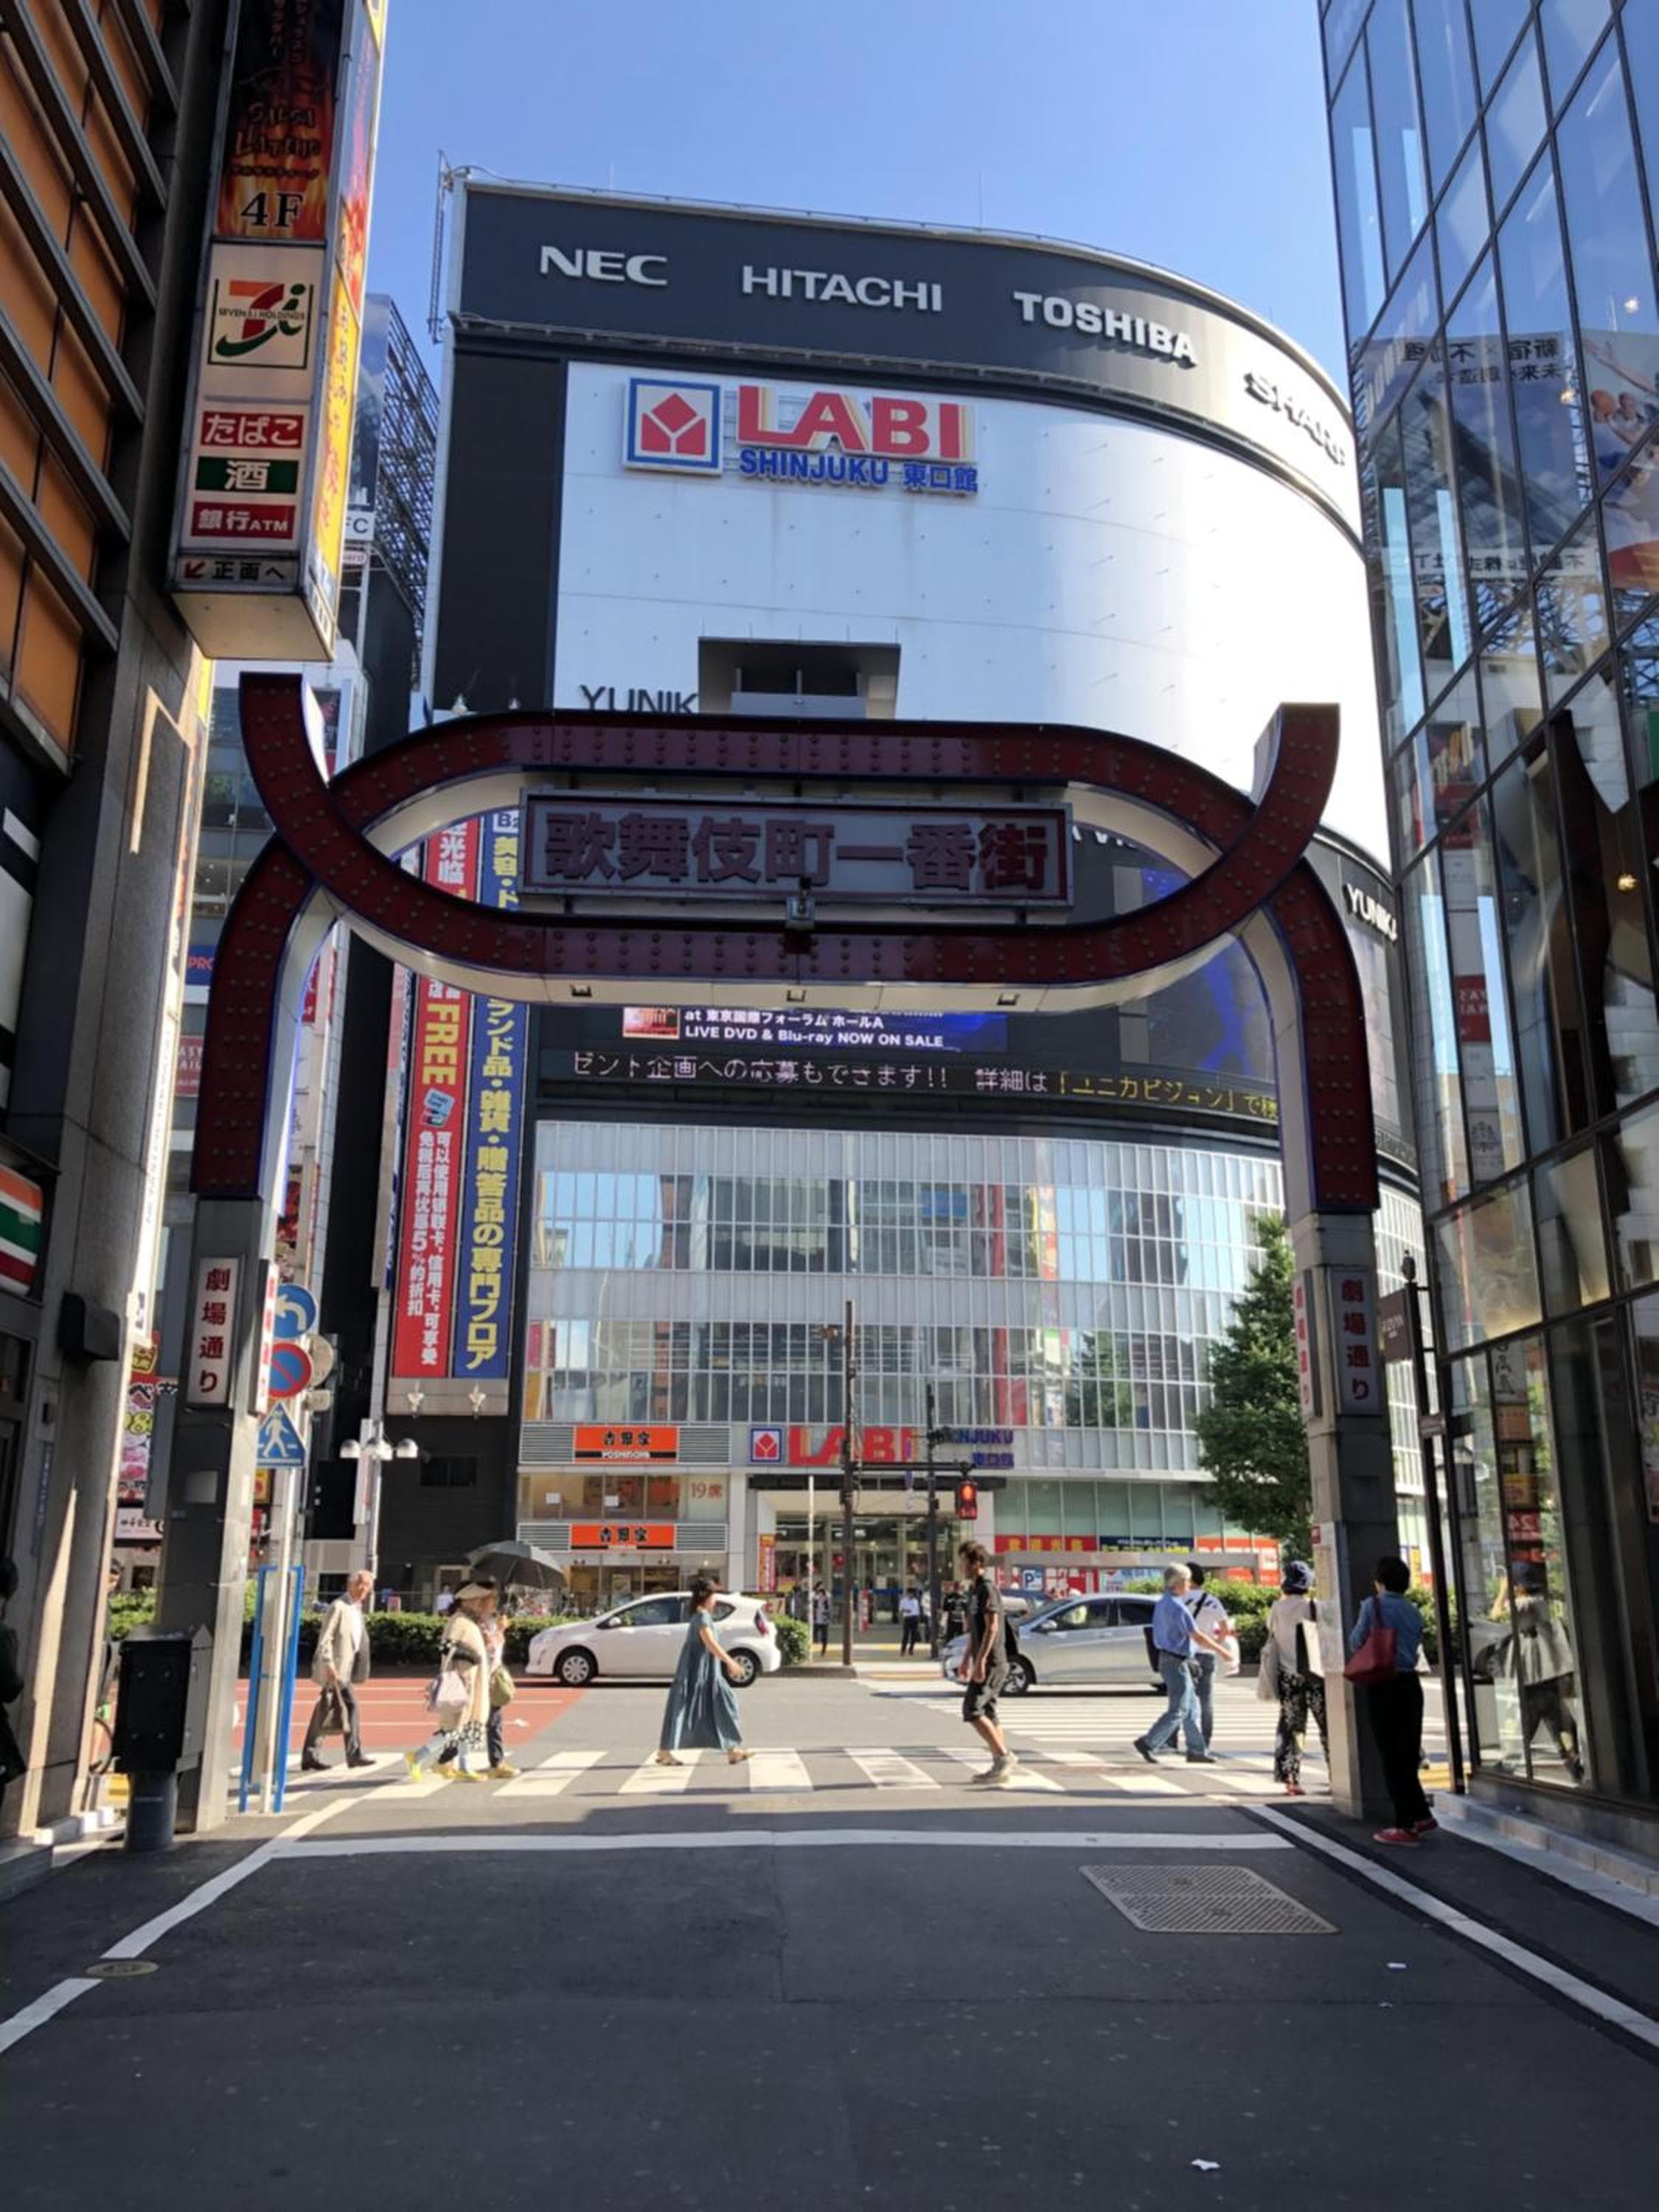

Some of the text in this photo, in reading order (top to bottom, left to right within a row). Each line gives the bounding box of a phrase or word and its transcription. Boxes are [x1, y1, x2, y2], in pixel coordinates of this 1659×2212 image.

[240, 192, 304, 227] 4F
[540, 246, 1199, 368] NEC HITACHI TOSHIBA
[205, 414, 299, 445] たばこ
[737, 385, 972, 462] LABI
[224, 460, 271, 490] 酒
[740, 449, 979, 494] SHINJUKU 東口館
[198, 509, 288, 532] 銀行ATM
[212, 561, 285, 580] 正面へ
[544, 812, 1048, 891] 歌舞伎町一番街
[684, 1010, 702, 1022] at
[706, 1009, 828, 1026] 東京国際フォーラム
[685, 1026, 945, 1048] LIVE DVD & Blu-ray NOW ON SALE
[422, 1003, 460, 1085] FREE
[198, 1267, 231, 1393] 劇場通り
[1341, 1279, 1371, 1401] 劇場通り
